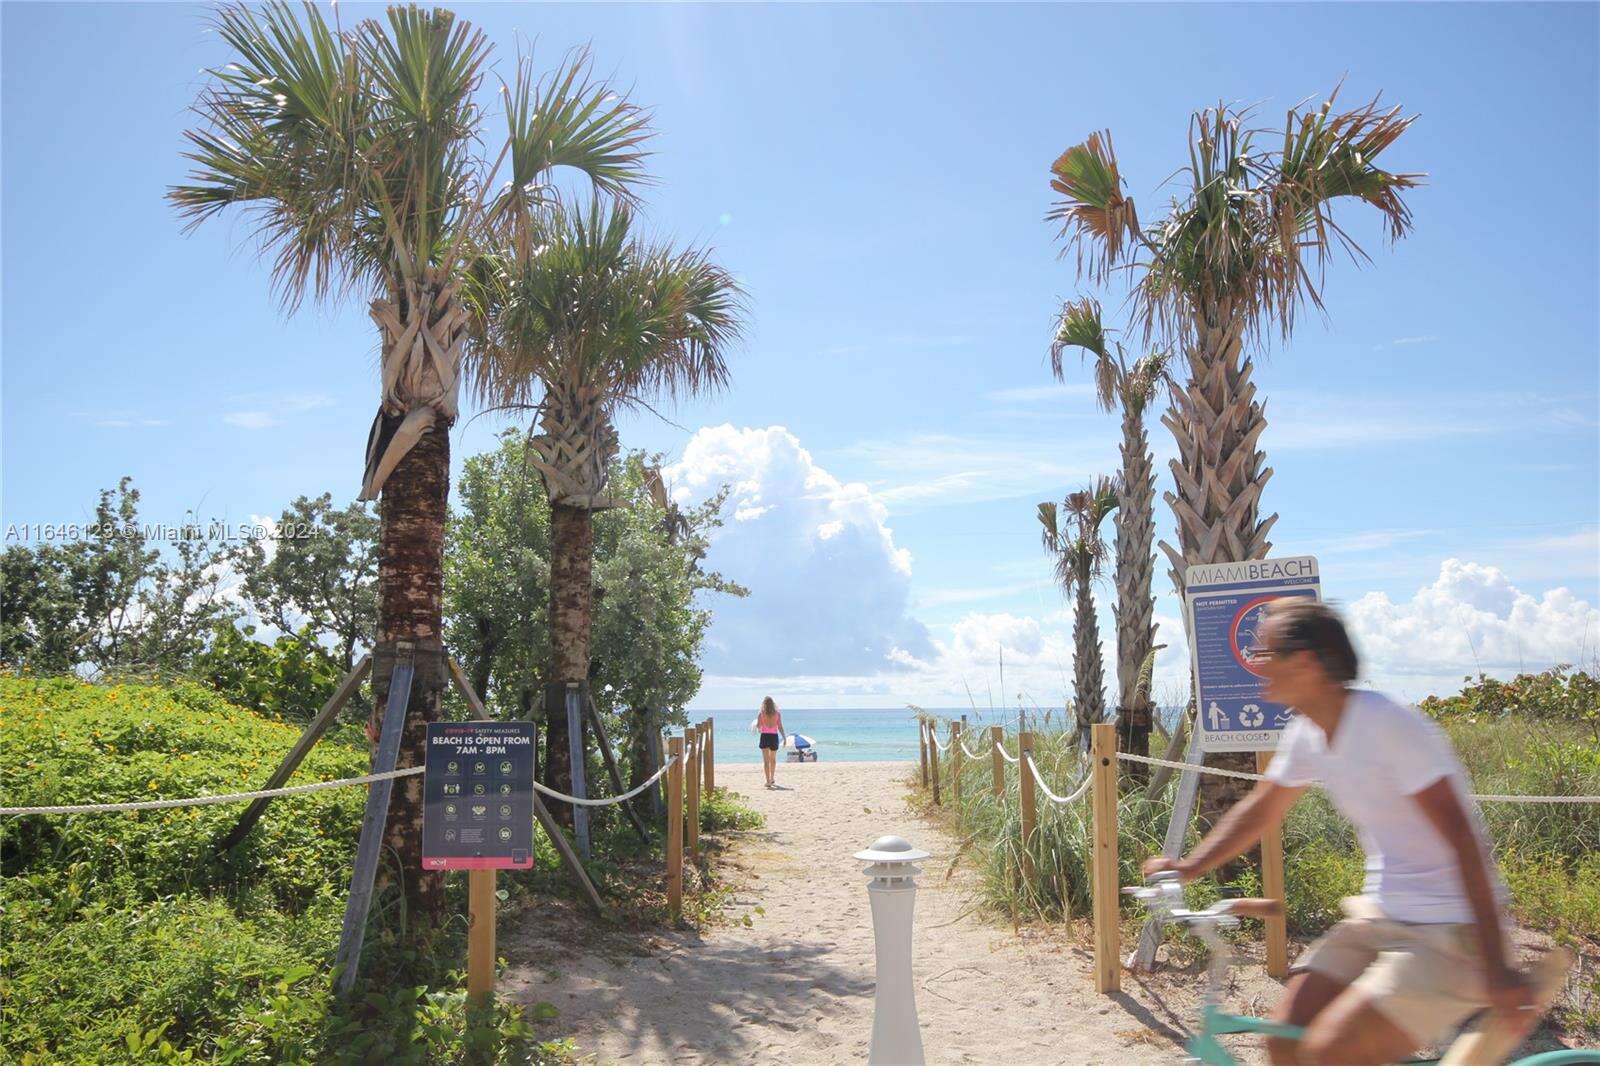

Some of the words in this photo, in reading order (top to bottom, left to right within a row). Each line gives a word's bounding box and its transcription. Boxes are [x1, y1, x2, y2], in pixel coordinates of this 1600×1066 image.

[432, 736, 462, 745] BEACH
[465, 736, 473, 745] IS
[475, 736, 500, 745] OPEN
[503, 736, 530, 745] FROM
[1205, 733, 1233, 742] BEACH
[1235, 732, 1270, 741] CLOSED
[456, 746, 477, 754] 7AM
[485, 746, 506, 754] 8PM
